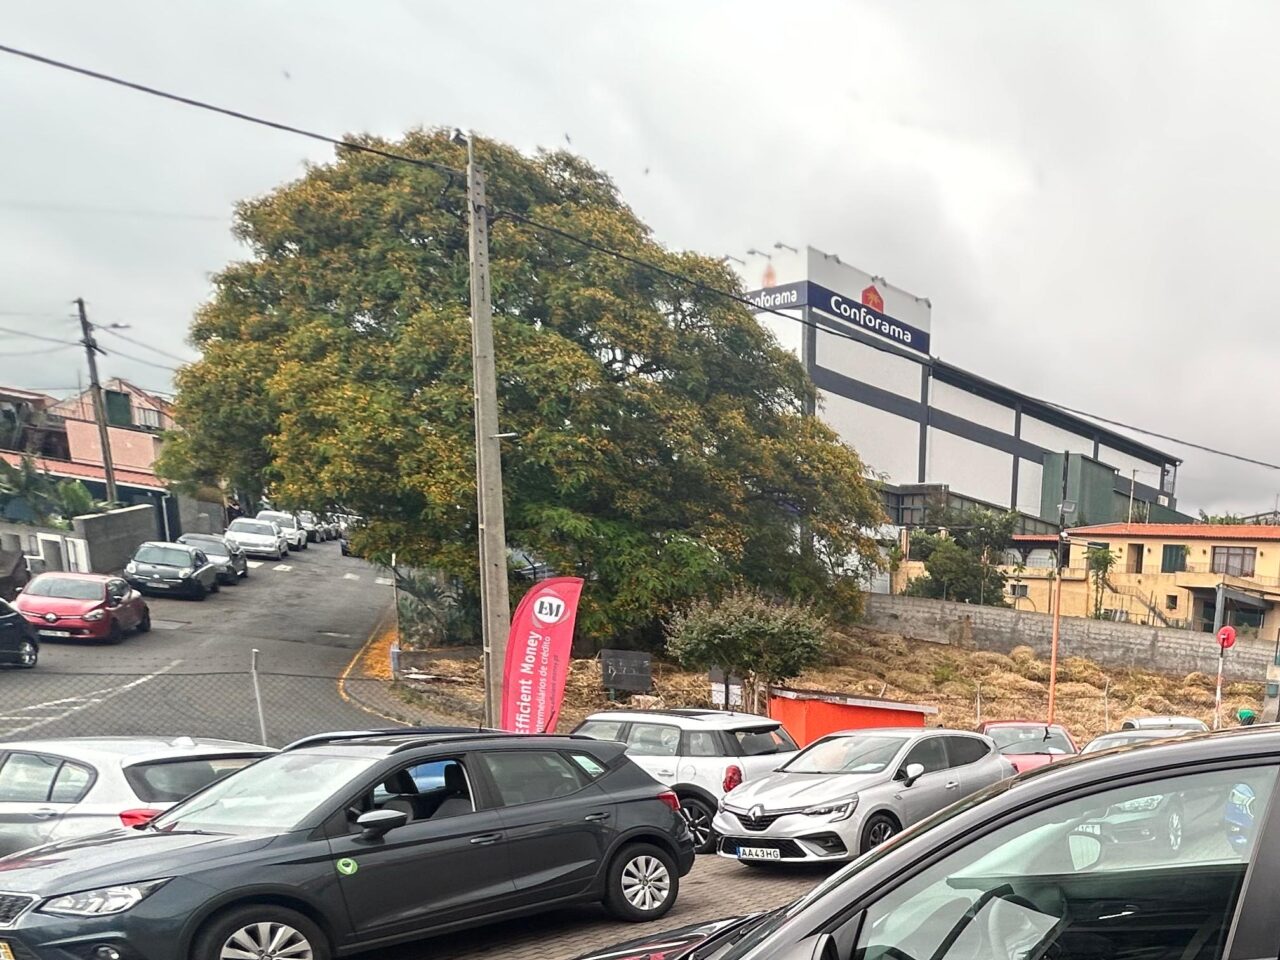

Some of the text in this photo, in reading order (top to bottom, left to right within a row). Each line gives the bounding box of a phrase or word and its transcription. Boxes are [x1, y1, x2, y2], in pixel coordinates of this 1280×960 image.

[830, 295, 912, 343] Conforama
[540, 635, 551, 665] crédito
[515, 630, 543, 734] Efficient Money
[539, 665, 548, 677] de
[741, 848, 779, 859] AA43HG
